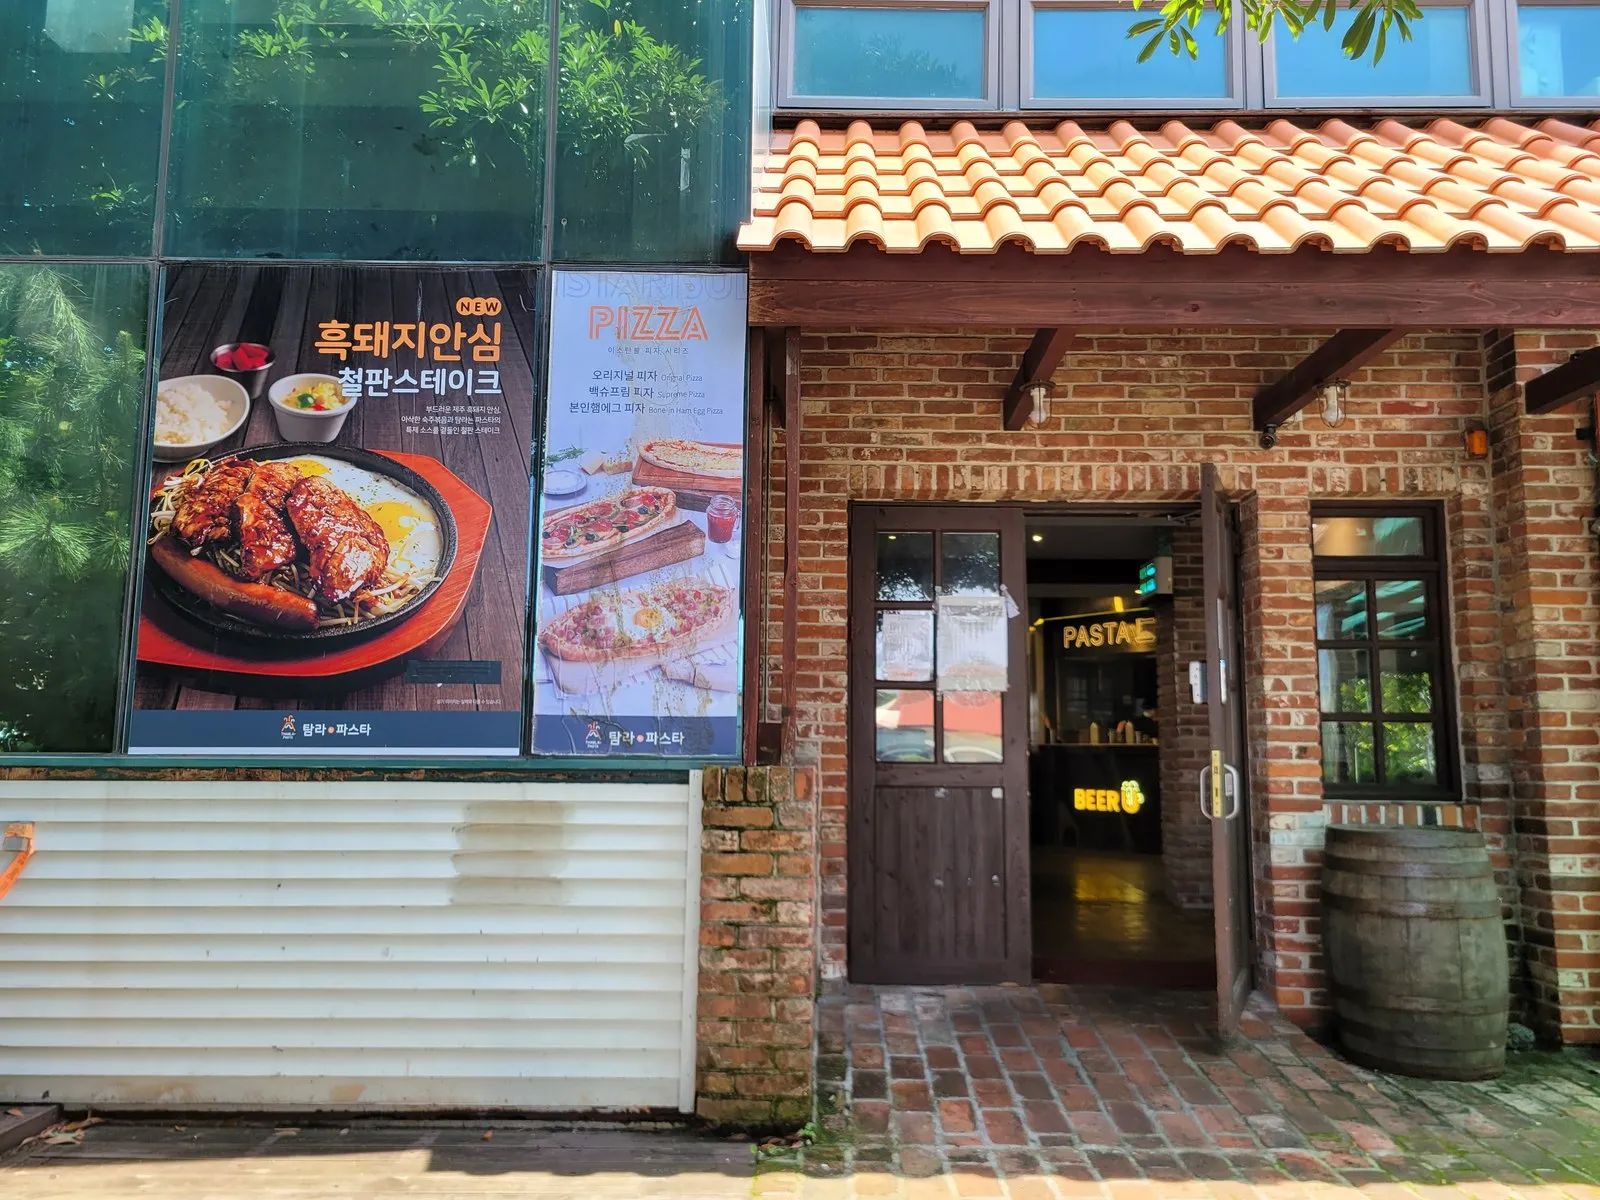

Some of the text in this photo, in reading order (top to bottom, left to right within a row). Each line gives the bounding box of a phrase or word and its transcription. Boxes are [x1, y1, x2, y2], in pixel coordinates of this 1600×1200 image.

[460, 301, 499, 312] NEW
[589, 305, 709, 340] PIZZA
[314, 320, 501, 361] 흑돼지안심
[645, 346, 661, 355] 피자
[665, 346, 689, 355] 시리즈
[338, 366, 502, 397] 철판스테이크
[592, 370, 634, 382] 오리지널
[636, 370, 658, 382] 피자
[686, 374, 703, 382] Pizza
[589, 386, 630, 398] 백슈프림
[633, 387, 654, 399] 피자
[688, 390, 705, 398] Pizza
[426, 405, 452, 414] 부드러운
[452, 405, 466, 414] 제주
[467, 405, 486, 414] 흑돼지
[569, 402, 621, 414] 본인햄에그
[624, 403, 645, 414] 피자
[676, 406, 692, 414] Ham
[693, 406, 706, 416] Egg
[706, 406, 723, 414] Pizza
[475, 415, 501, 424] 파스타의
[420, 426, 439, 434] 소스를
[461, 426, 474, 435] 철판
[475, 426, 501, 434] 스테이크
[1063, 620, 1131, 649] PASTA
[302, 723, 372, 737] 탐라 파스타
[609, 731, 685, 745] 탐라 파스타
[1073, 788, 1121, 813] BEER
